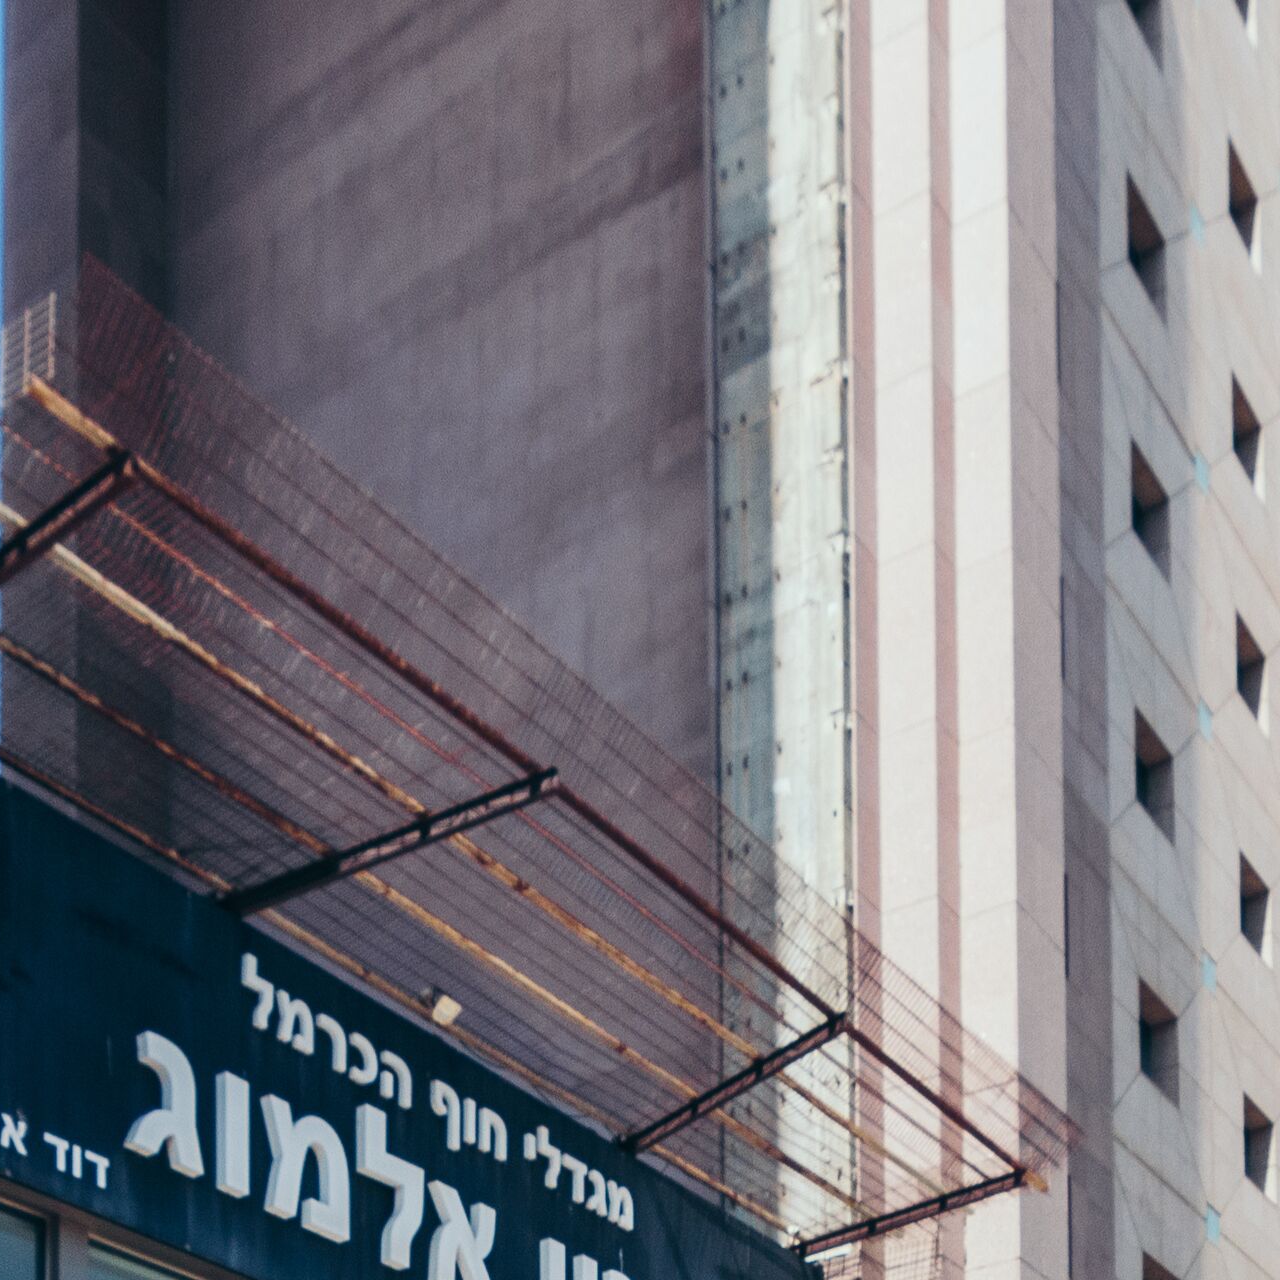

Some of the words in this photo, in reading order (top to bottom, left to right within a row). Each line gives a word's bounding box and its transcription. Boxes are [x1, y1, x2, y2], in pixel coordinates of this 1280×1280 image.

[241, 952, 413, 1110] הכרמל
[43, 1131, 111, 1190] דוד
[429, 1078, 508, 1163] חוף
[523, 1125, 634, 1232] מגדלי
